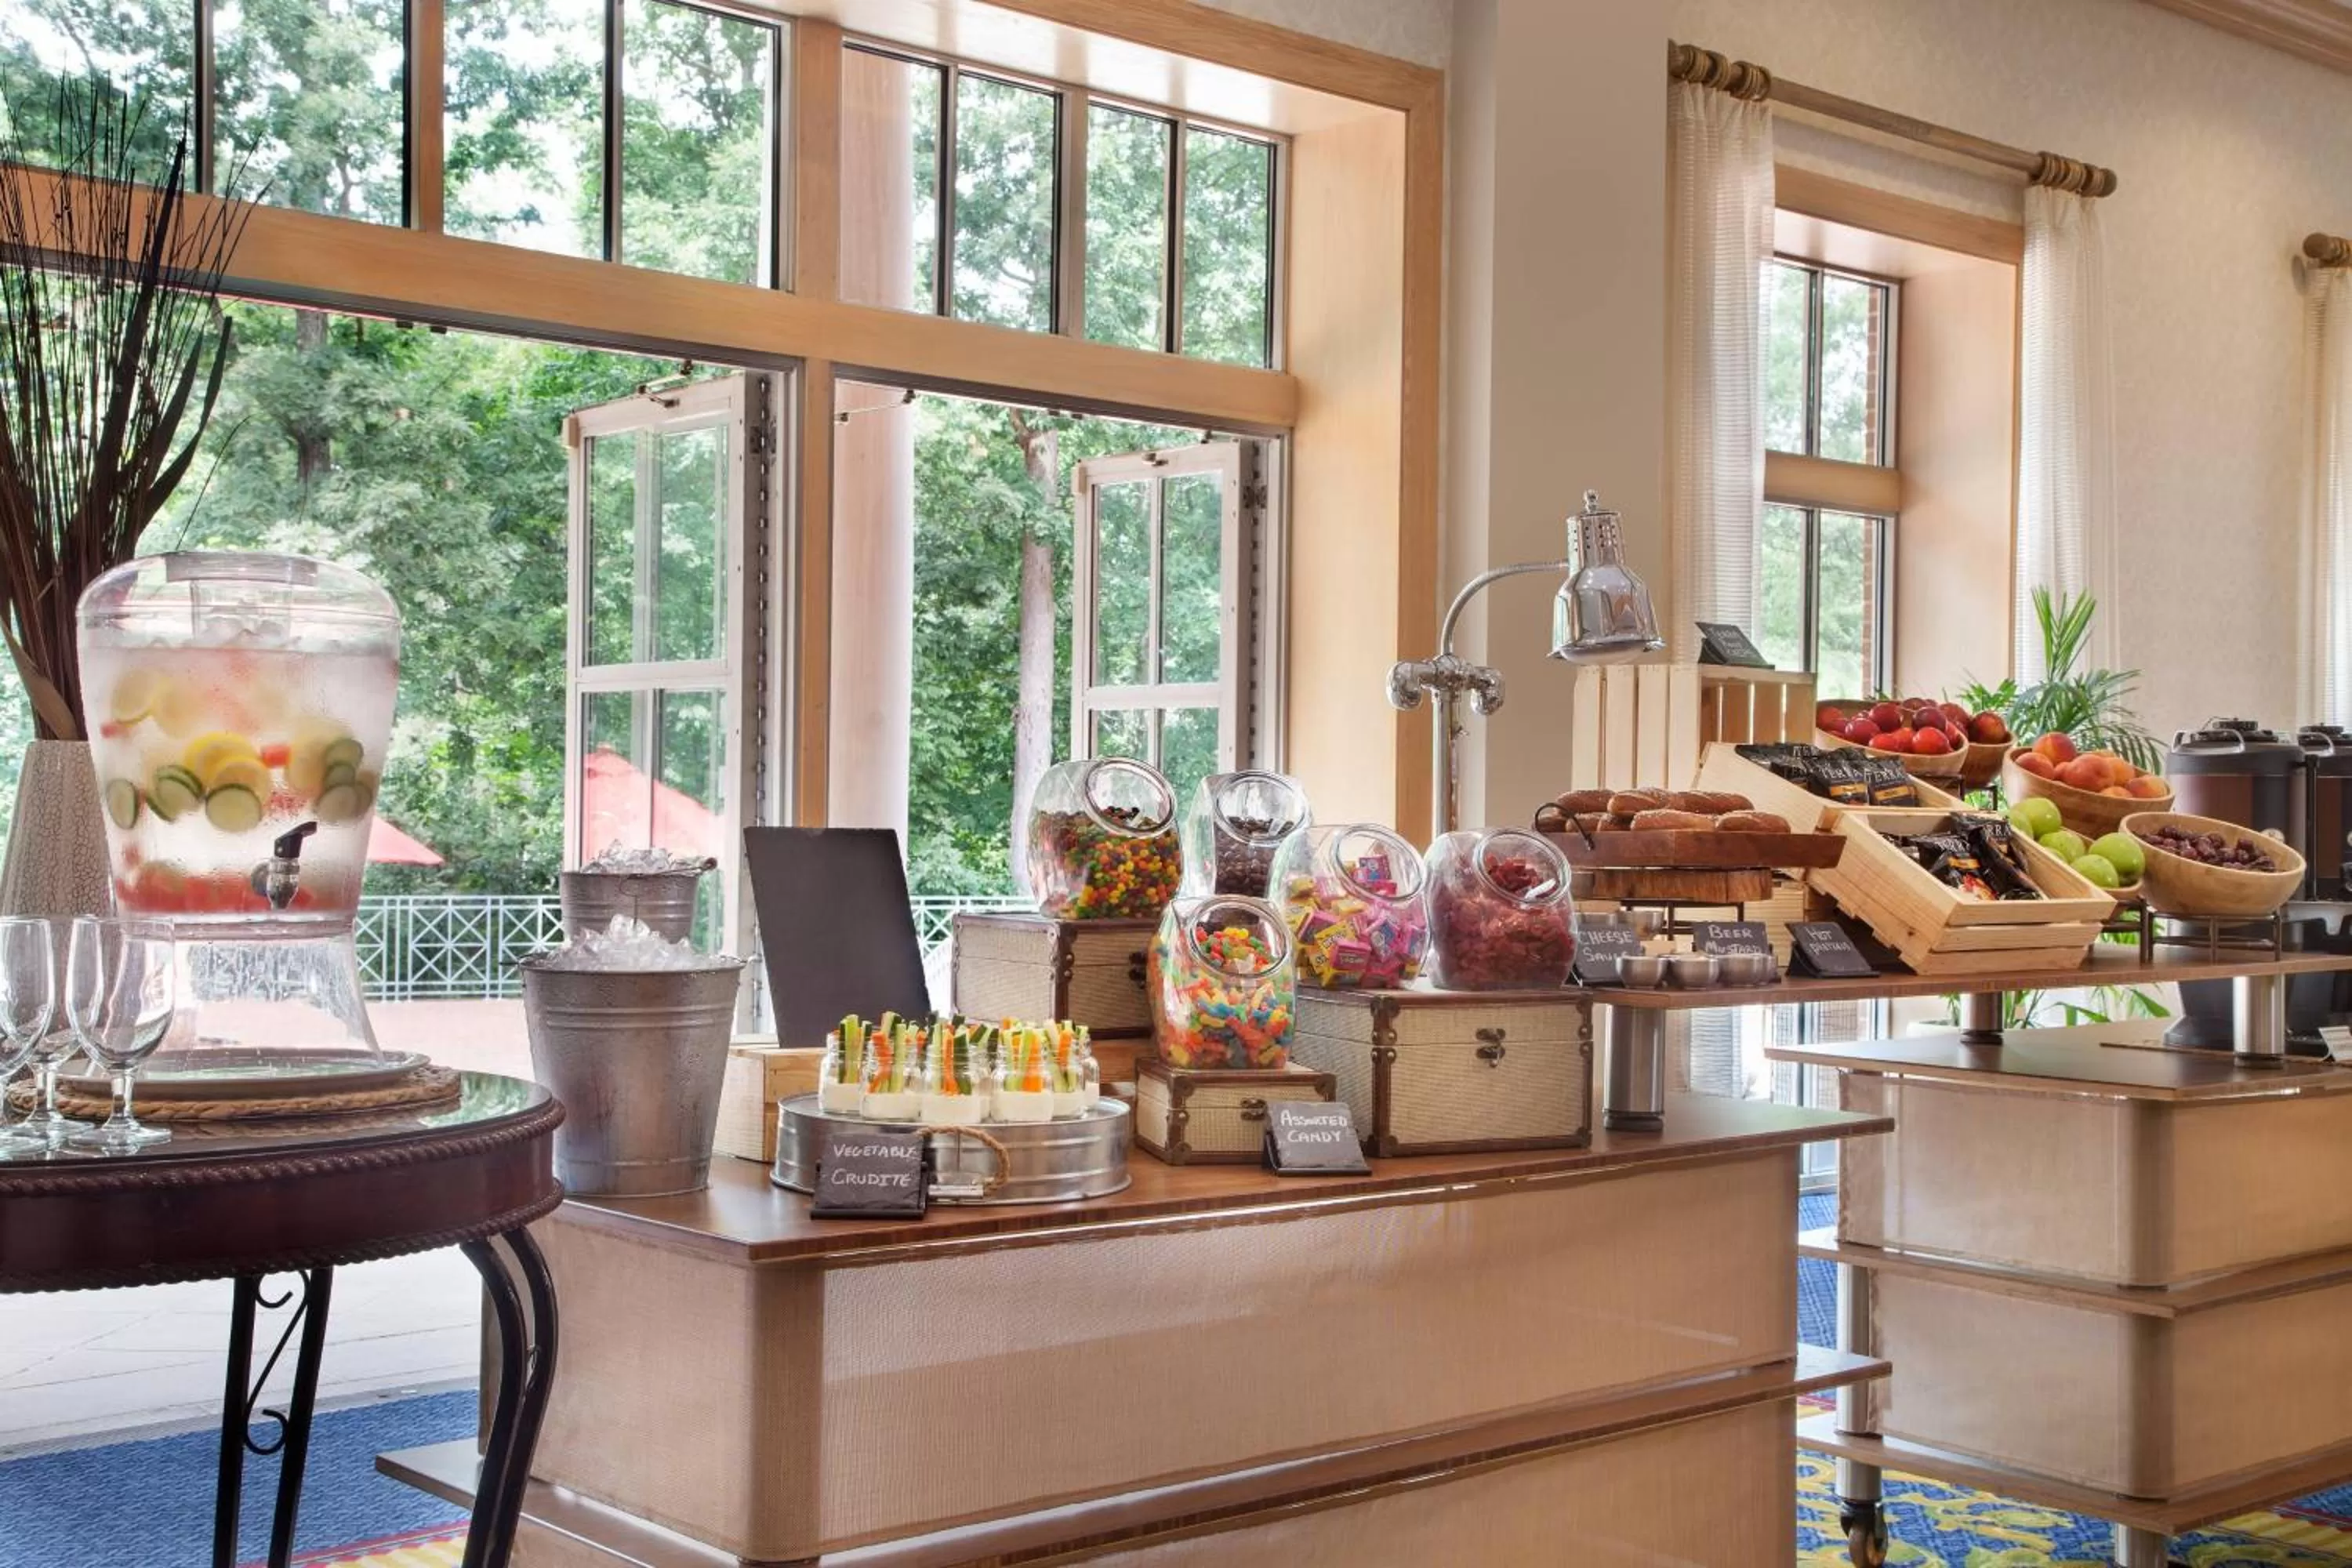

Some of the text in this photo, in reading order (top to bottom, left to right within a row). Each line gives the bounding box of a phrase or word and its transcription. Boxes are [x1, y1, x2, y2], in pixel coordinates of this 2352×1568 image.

[1985, 824, 2012, 837] RRA
[1577, 930, 1632, 945] CHEESE
[1708, 924, 1753, 938] BEER
[1287, 1129, 1342, 1143] CANDY
[833, 1143, 920, 1159] VEGETABLE
[830, 1167, 912, 1188] CRUDITE
